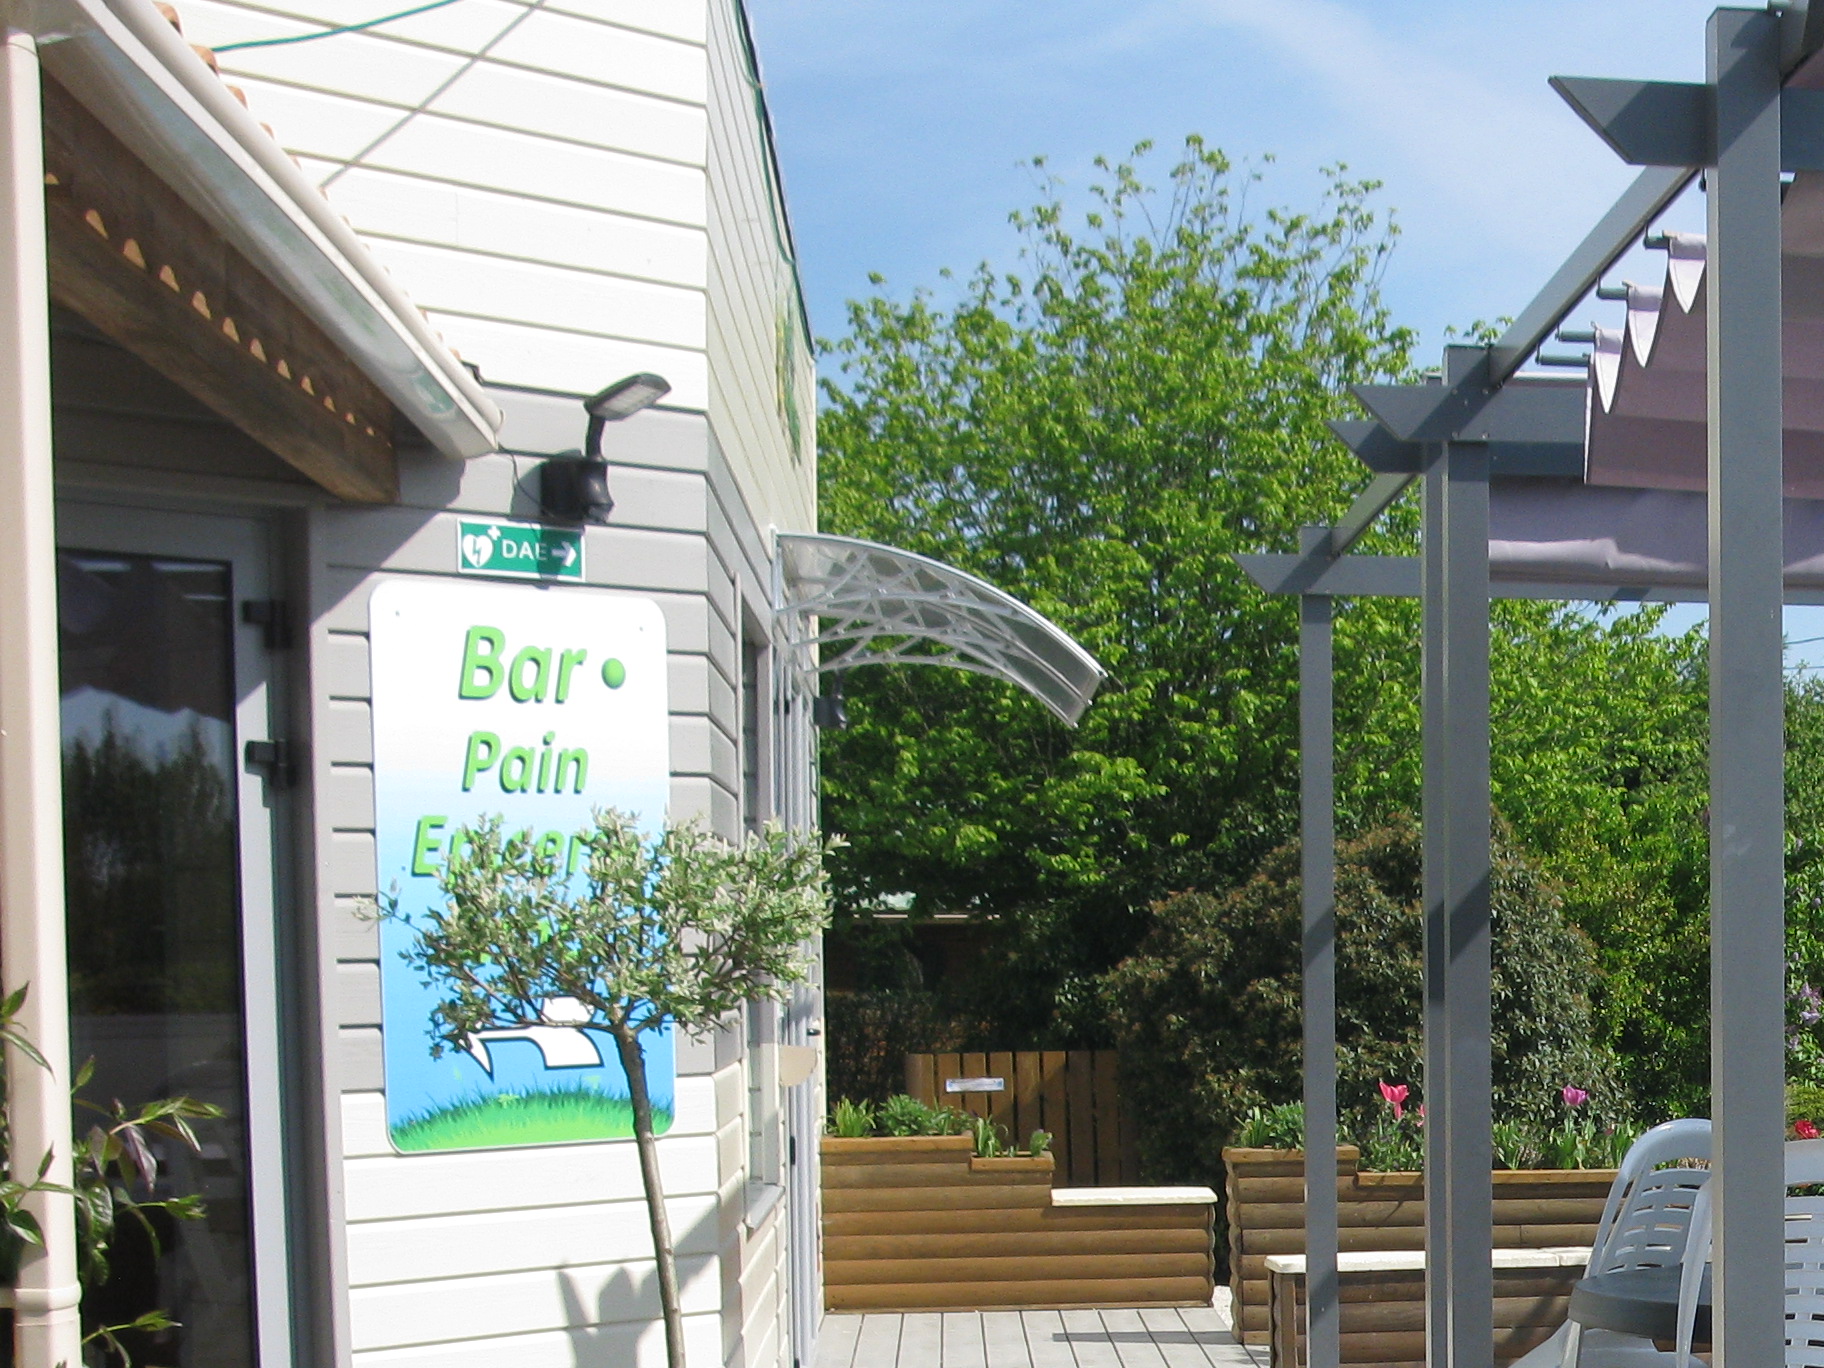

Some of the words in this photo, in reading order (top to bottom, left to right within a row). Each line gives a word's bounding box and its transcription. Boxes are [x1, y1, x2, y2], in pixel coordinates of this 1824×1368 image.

[501, 538, 549, 561] DAE
[458, 625, 588, 704] Bar
[462, 731, 588, 794] Pain
[411, 814, 645, 888] Epcer
